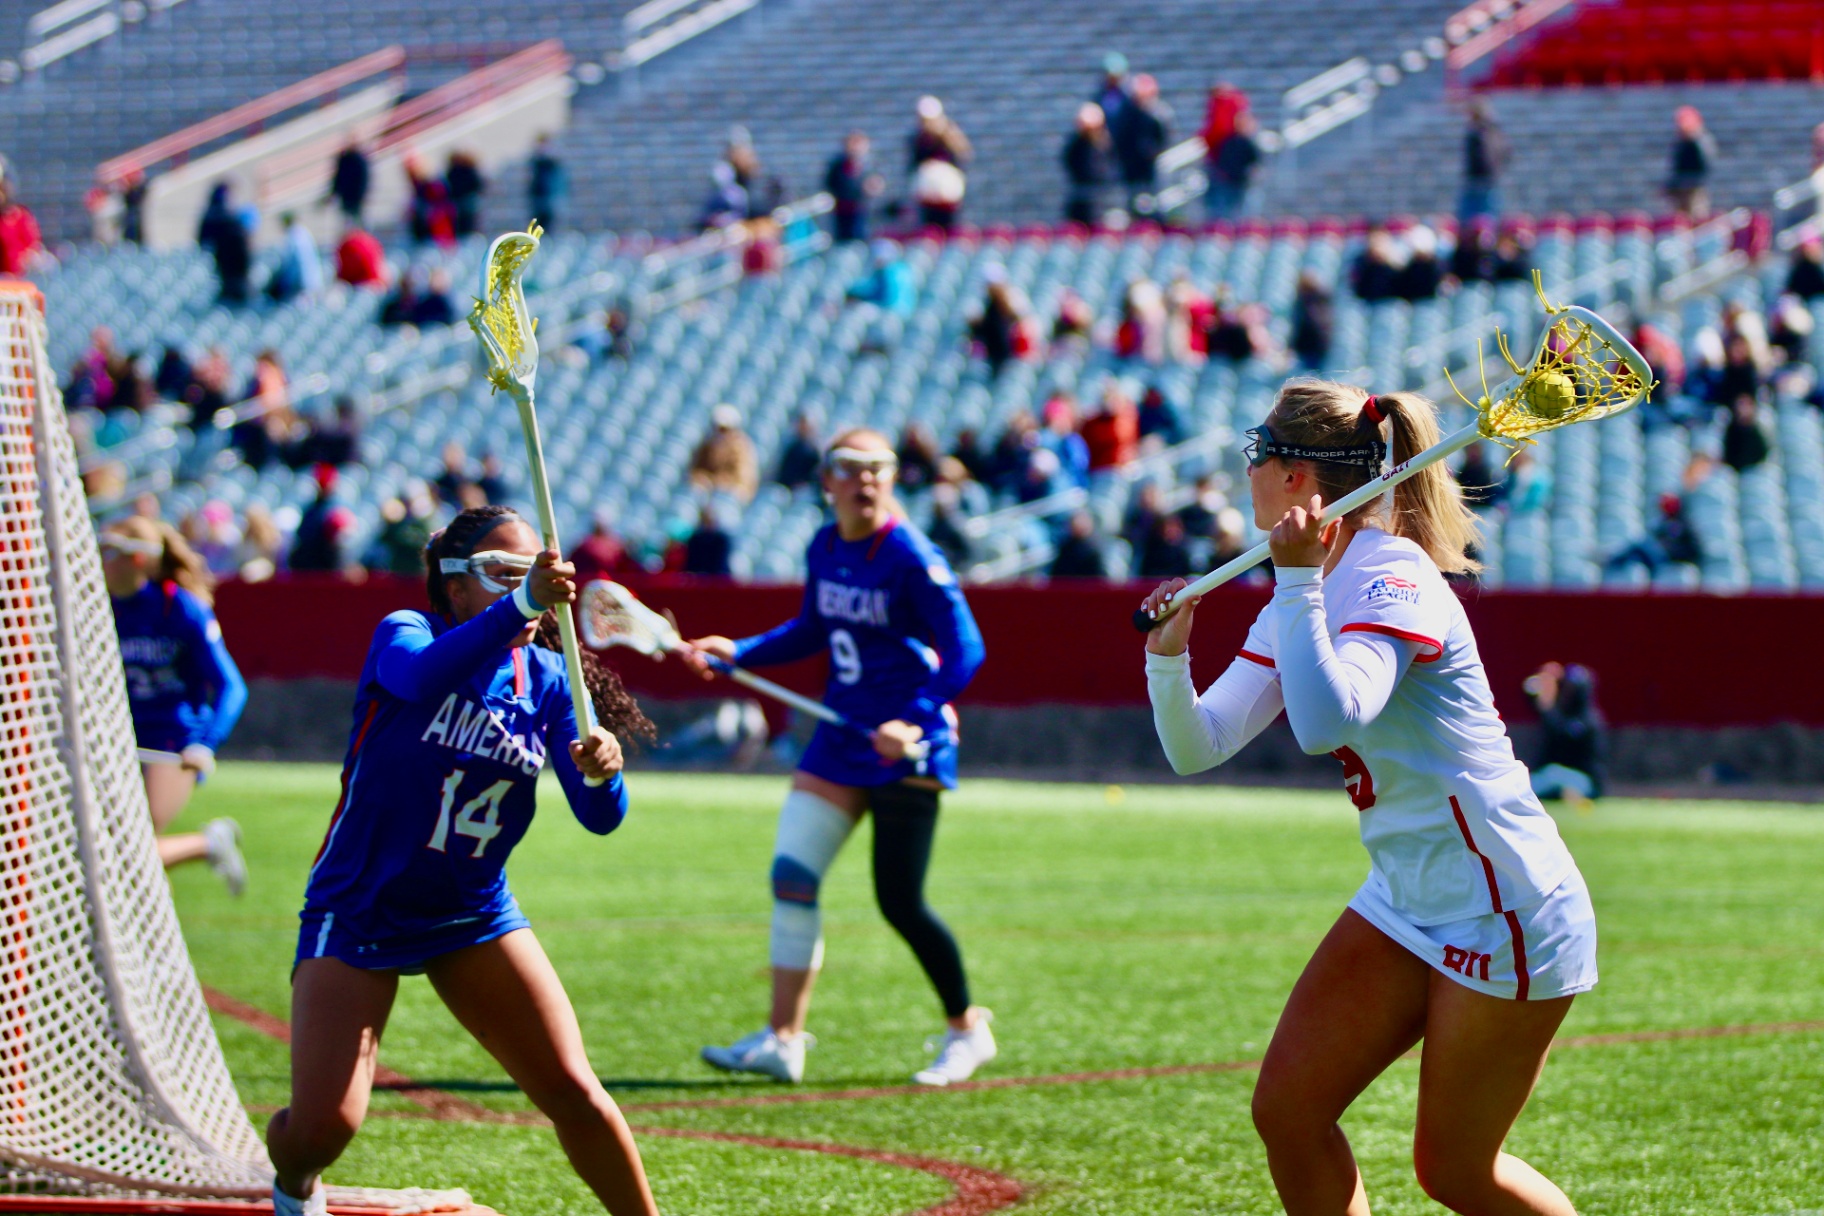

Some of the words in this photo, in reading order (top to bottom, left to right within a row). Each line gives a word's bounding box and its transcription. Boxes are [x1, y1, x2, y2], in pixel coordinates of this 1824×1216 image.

[1302, 450, 1345, 458] UNDER
[829, 628, 861, 685] 9
[427, 768, 514, 858] 14
